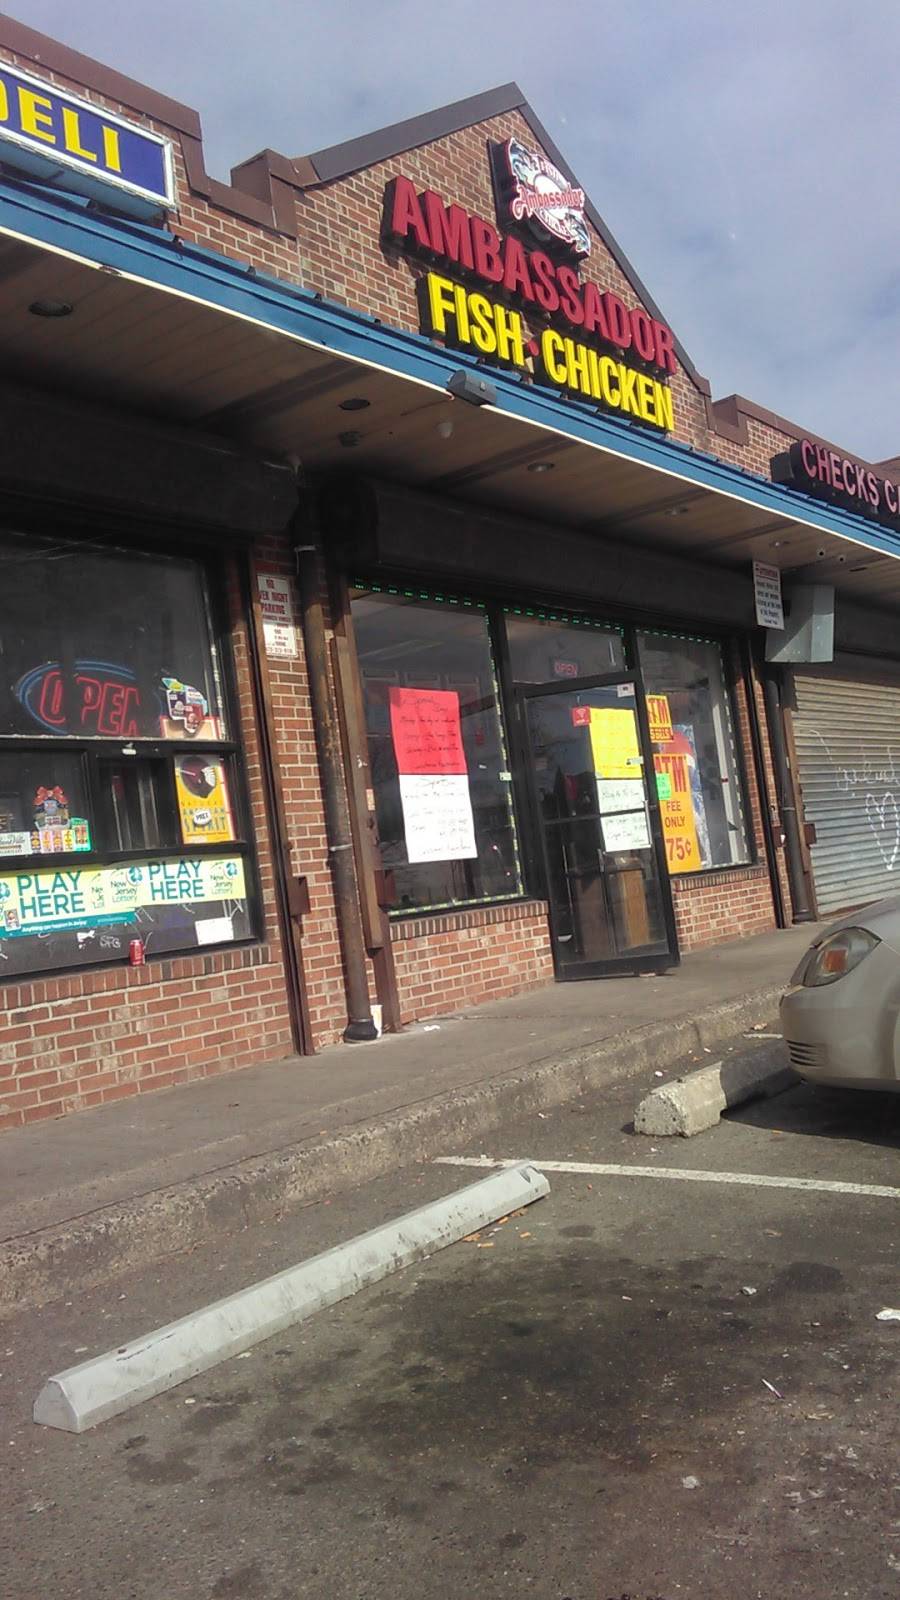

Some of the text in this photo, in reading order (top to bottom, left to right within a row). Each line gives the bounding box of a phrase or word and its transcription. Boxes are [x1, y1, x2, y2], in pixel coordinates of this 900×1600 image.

[391, 175, 677, 375] AMBASSADOR
[427, 271, 675, 432] FISH CHICKEN
[801, 439, 900, 524] CHECKS C
[666, 800, 682, 812] FEE
[665, 815, 686, 828] ONLY
[666, 837, 692, 861] 75¢
[148, 859, 202, 881] PLAY
[16, 870, 82, 897] PLAY
[110, 880, 127, 888] New
[115, 887, 138, 896] Jersey
[150, 879, 205, 901] HERE
[214, 881, 233, 889] Jersey
[19, 893, 86, 920] HERE
